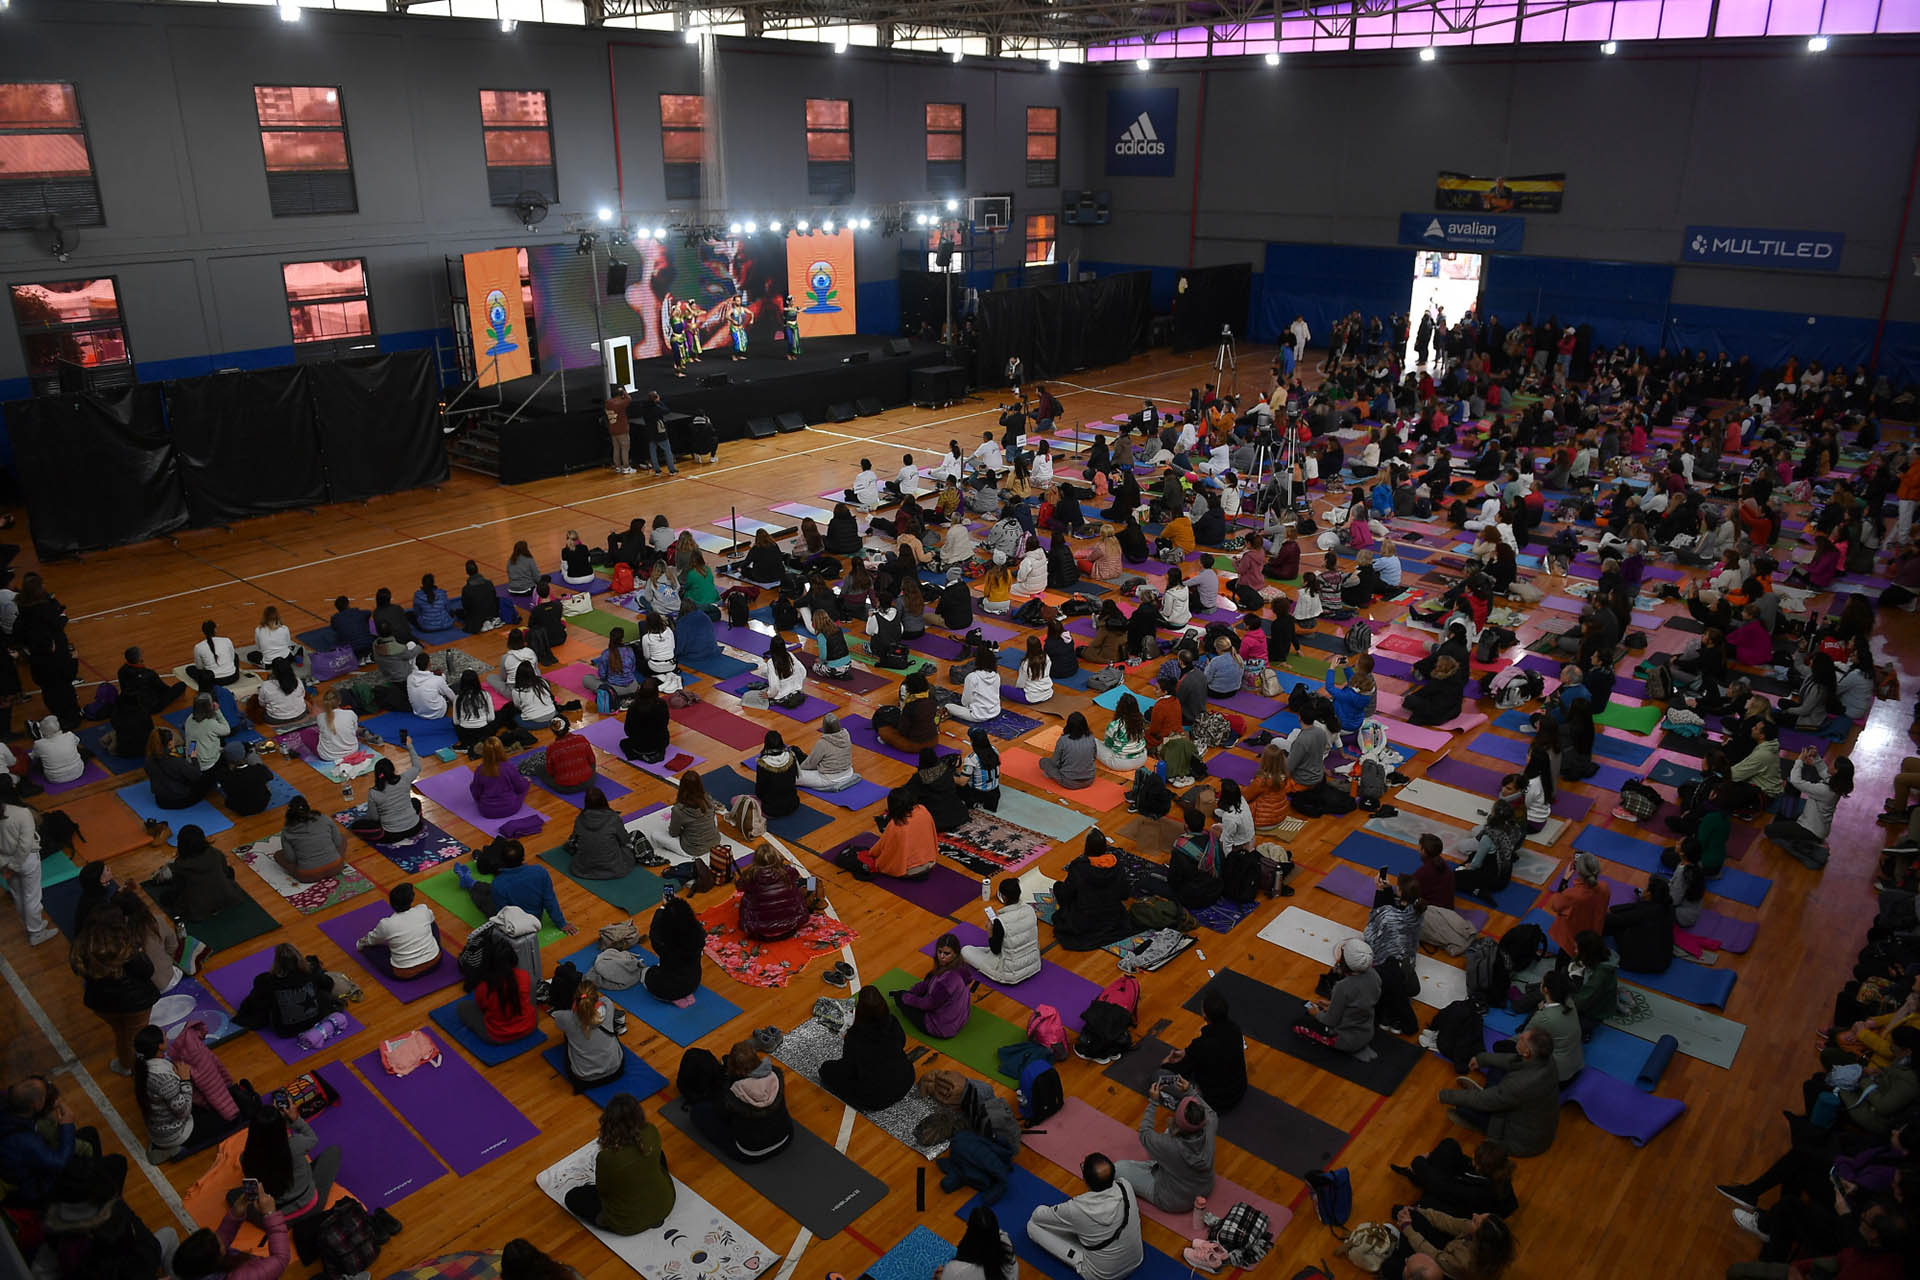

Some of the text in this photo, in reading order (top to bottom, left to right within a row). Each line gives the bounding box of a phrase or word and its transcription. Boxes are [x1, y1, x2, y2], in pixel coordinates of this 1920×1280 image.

[1115, 139, 1165, 155] adidas
[1448, 221, 1496, 236] avalian
[1712, 237, 1833, 259] MULTILED
